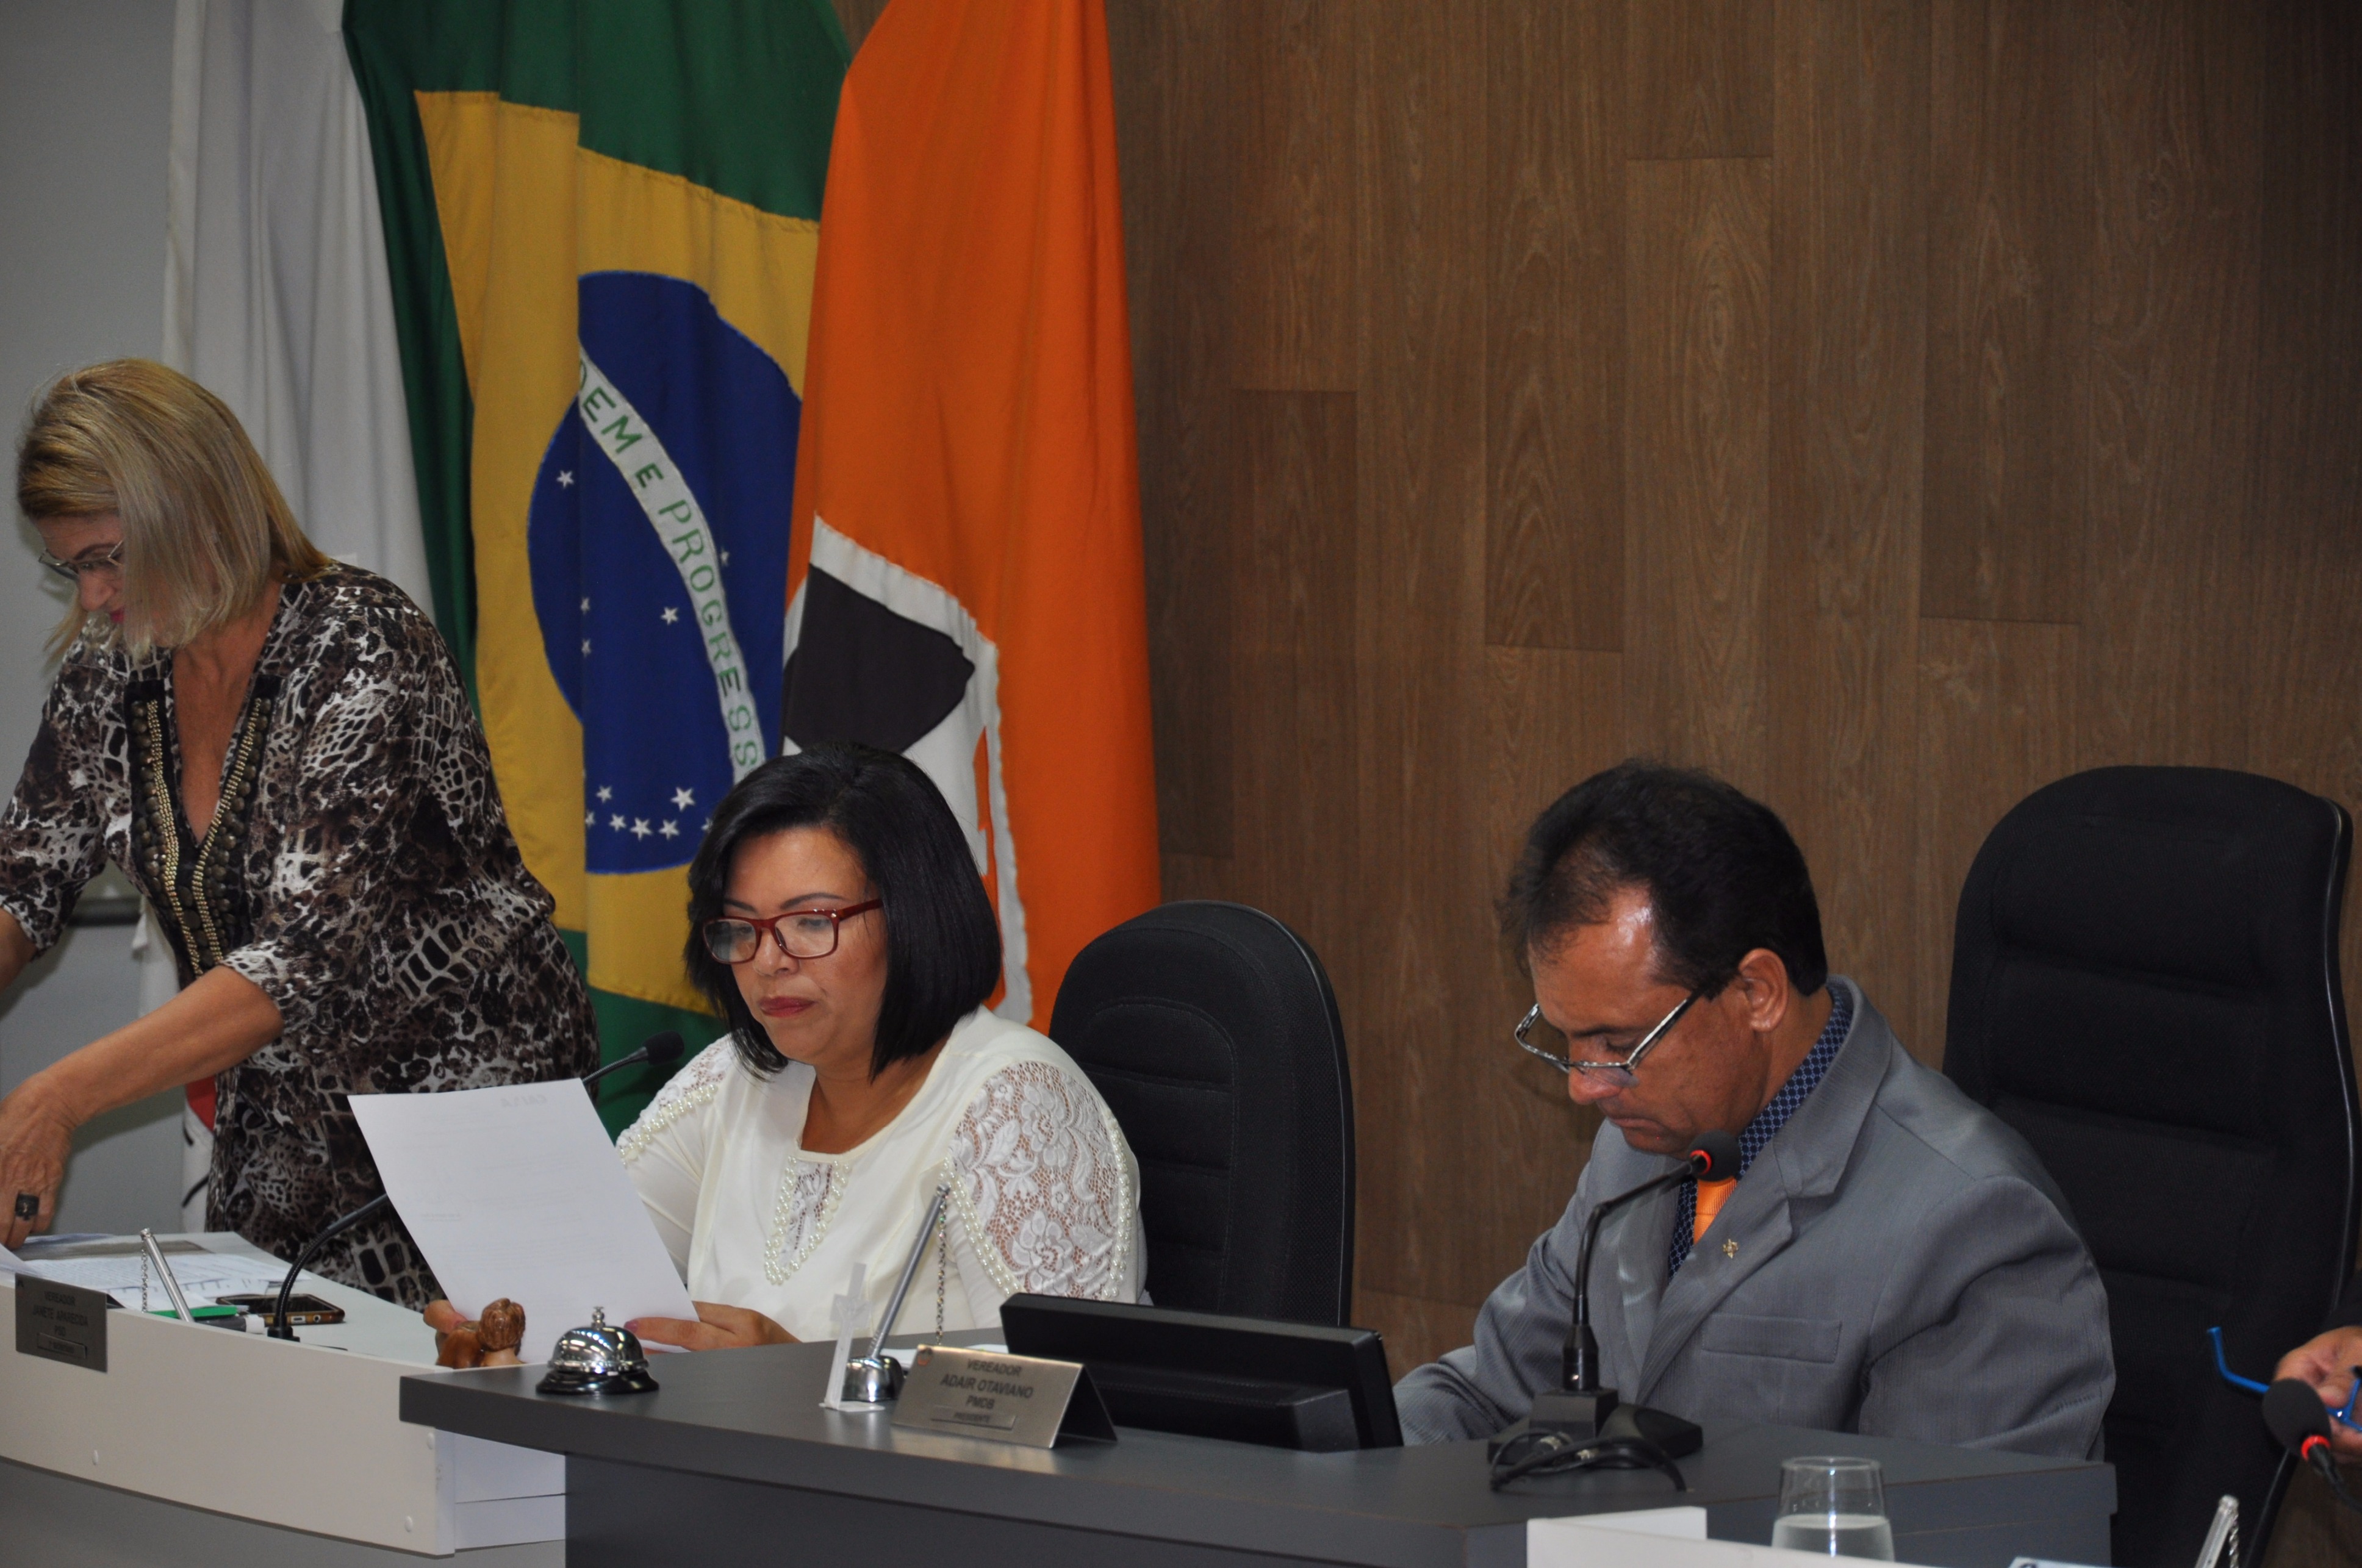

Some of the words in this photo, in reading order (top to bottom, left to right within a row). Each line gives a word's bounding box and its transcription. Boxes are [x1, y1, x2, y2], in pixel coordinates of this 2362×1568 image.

[580, 359, 643, 454] EM
[634, 462, 664, 488] E
[658, 499, 758, 767] PROGRESS
[967, 1359, 1022, 1376] VEREADOR
[940, 1373, 976, 1390] ADAIR
[977, 1379, 1034, 1398] OTAVIANO
[966, 1395, 996, 1409] PMDB
